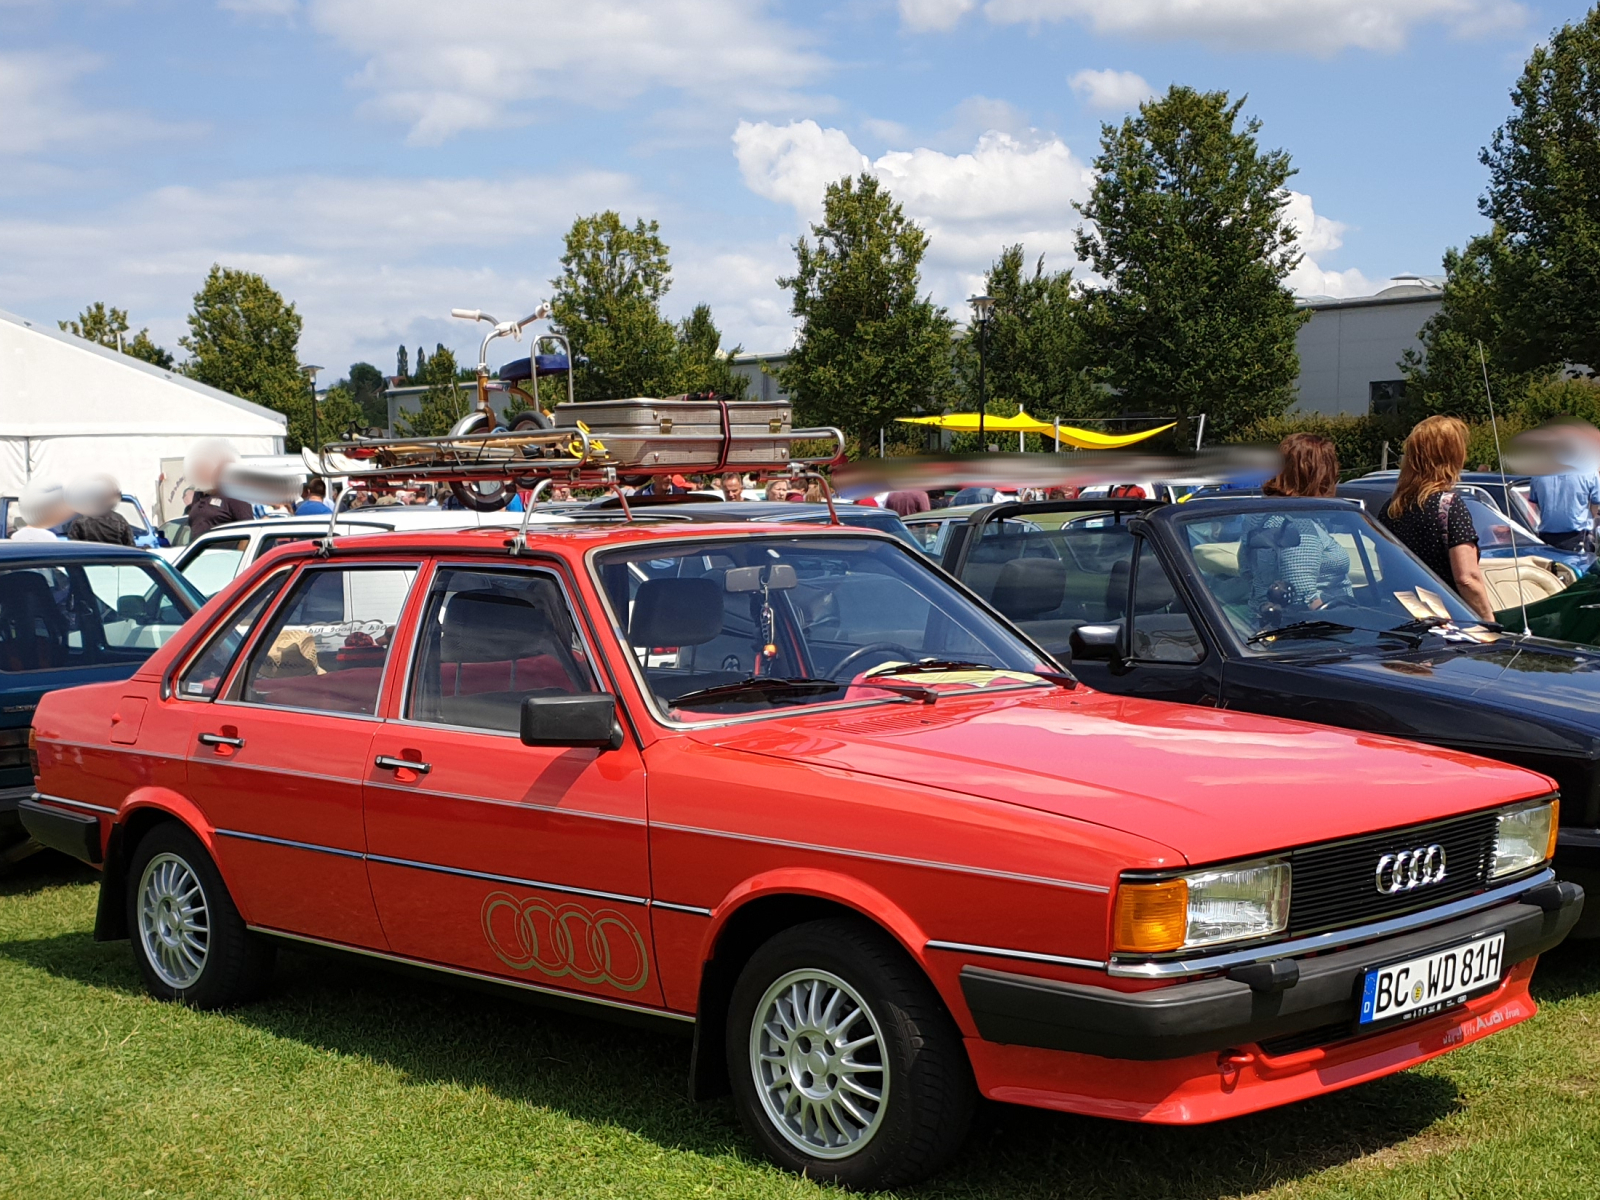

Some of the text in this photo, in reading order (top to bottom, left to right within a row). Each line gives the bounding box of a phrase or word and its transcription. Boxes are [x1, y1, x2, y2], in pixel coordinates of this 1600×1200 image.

[1375, 967, 1410, 1014] BC
[1427, 953, 1457, 999] WD
[1460, 938, 1502, 987] 81H
[1363, 1002, 1370, 1013] D
[1475, 1010, 1504, 1032] Audi
